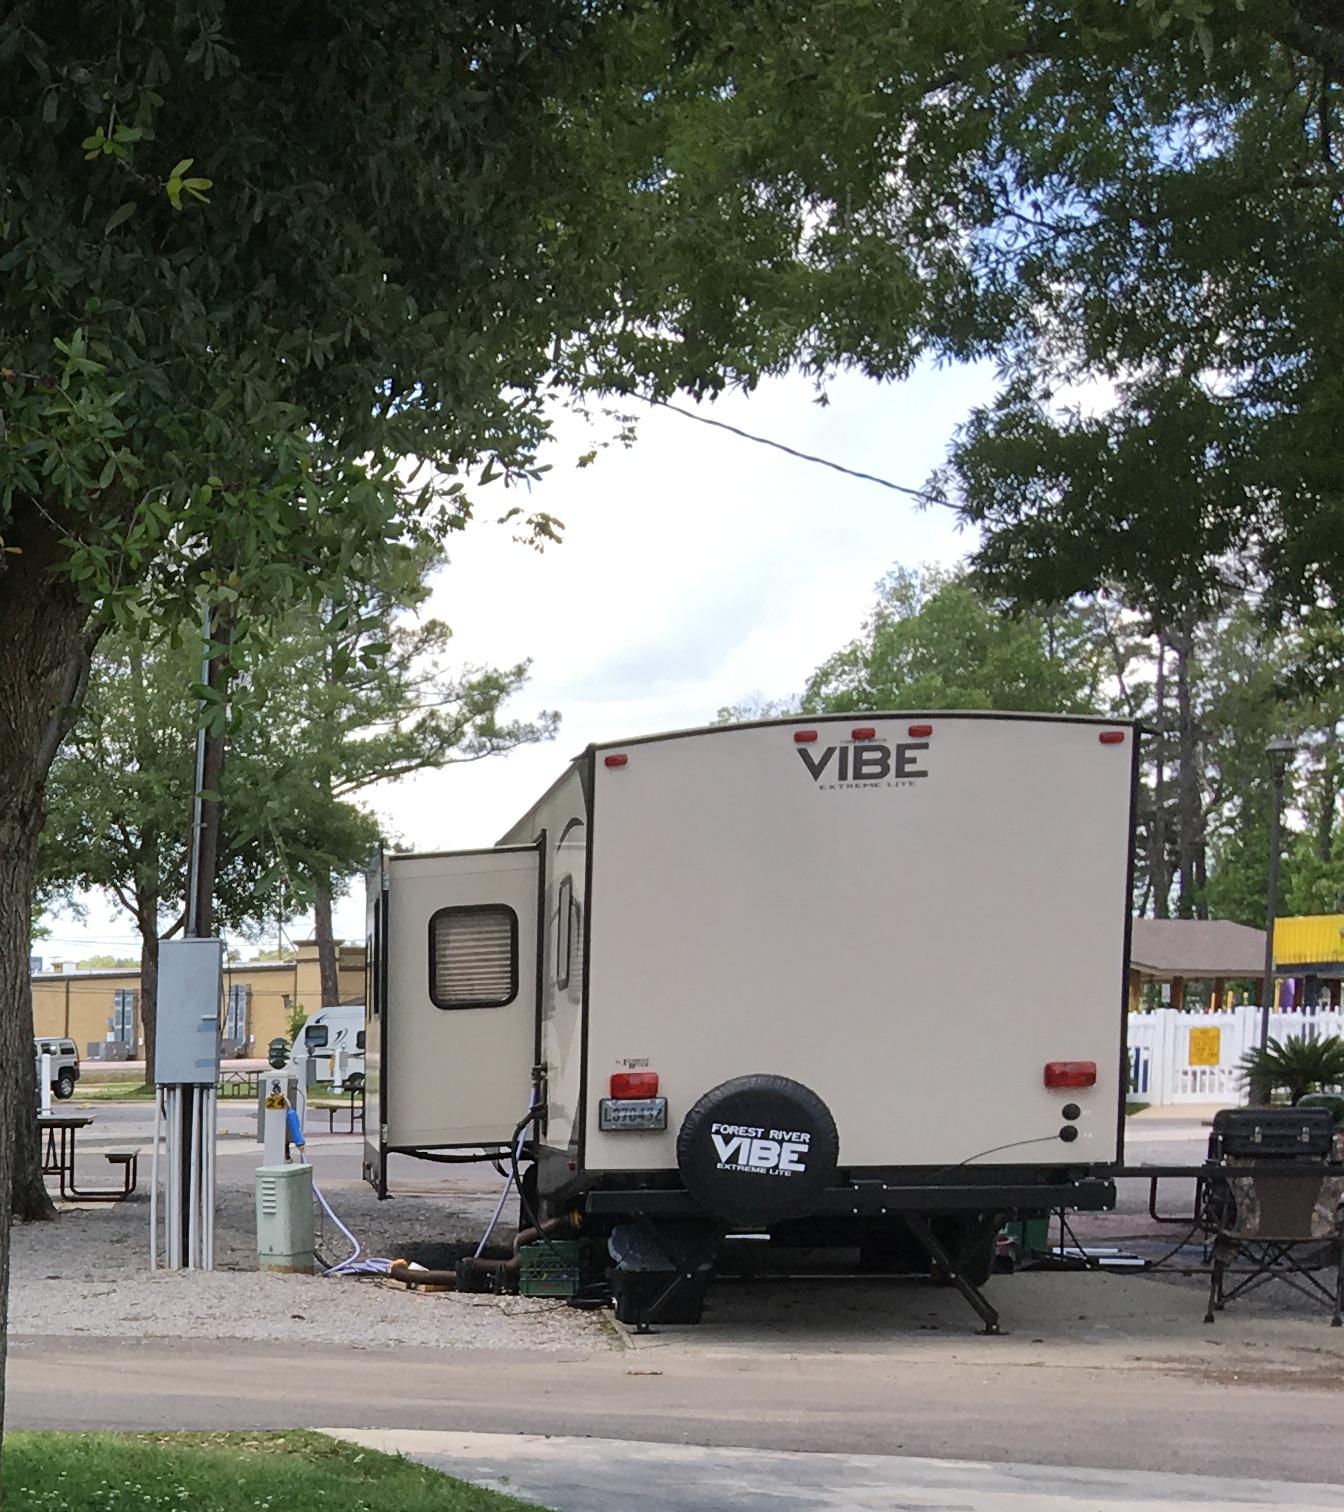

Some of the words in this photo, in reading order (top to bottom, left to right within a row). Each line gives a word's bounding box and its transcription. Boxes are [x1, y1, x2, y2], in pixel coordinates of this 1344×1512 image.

[797, 742, 929, 782] VIBE
[819, 782, 881, 790] EXTREME
[712, 1123, 765, 1138] FOREST
[769, 1129, 811, 1143] RIVER
[711, 1134, 809, 1172] VIBE
[716, 1162, 767, 1174] EXTREME
[769, 1168, 792, 1177] LITE
